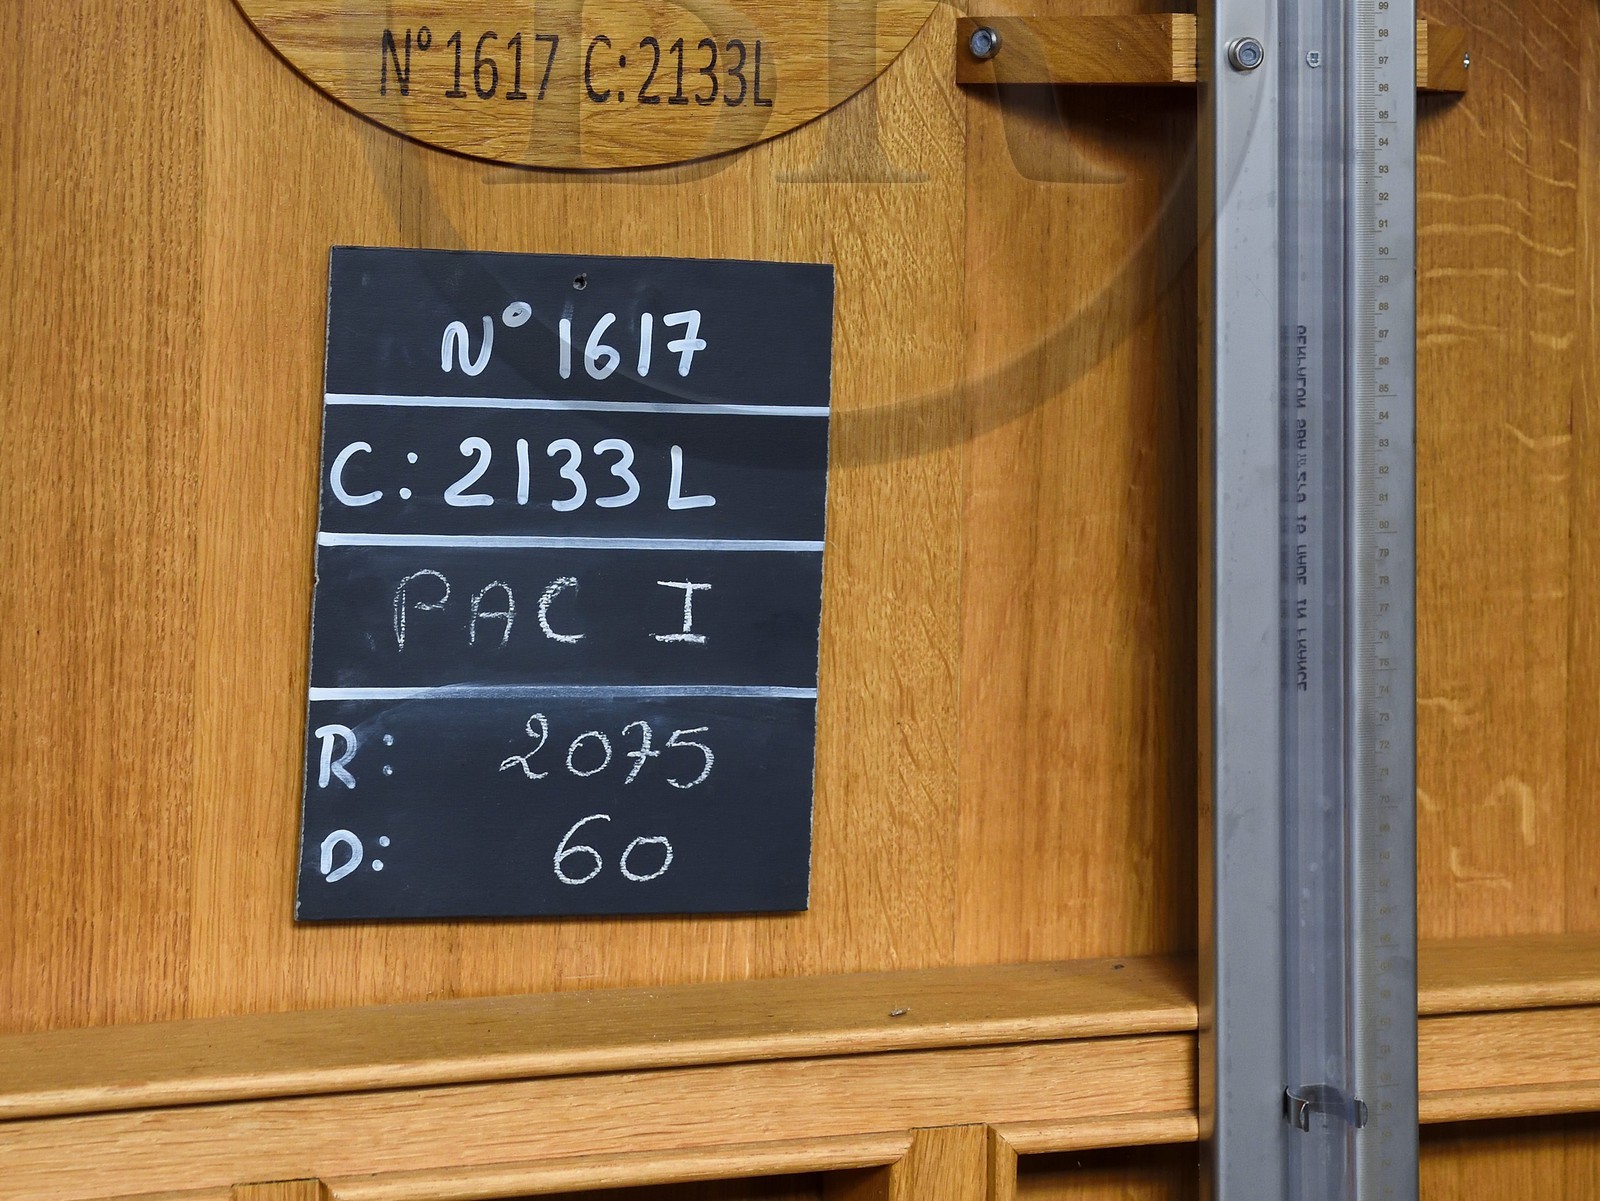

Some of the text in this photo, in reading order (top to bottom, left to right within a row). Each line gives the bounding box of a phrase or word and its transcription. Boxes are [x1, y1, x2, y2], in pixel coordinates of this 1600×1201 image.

[1378, 1, 1389, 11] 99
[1378, 28, 1389, 38] 98
[1378, 55, 1389, 65] 97
[1378, 83, 1389, 93] 96
[1378, 110, 1389, 120] 95
[1378, 137, 1389, 147] 94
[1378, 164, 1390, 174] 93
[1378, 191, 1389, 201] 92
[1378, 219, 1388, 229] 91
[1378, 246, 1389, 256] 90
[1378, 274, 1390, 284] 89
[1378, 301, 1390, 311] 88
[1378, 329, 1389, 339] 87
[559, 310, 706, 380] 1617
[1378, 356, 1390, 366] 86
[1378, 383, 1390, 393] 85
[1379, 410, 1390, 420] 84
[1379, 438, 1390, 448] 83
[444, 437, 641, 512] 2133
[668, 445, 716, 509] L
[1379, 465, 1390, 475] 82
[1379, 492, 1390, 502] 81
[1379, 520, 1390, 530] 80
[1379, 547, 1390, 557] 79
[1379, 575, 1390, 585] 78
[393, 568, 712, 652] PAC I
[1379, 602, 1390, 612] 77
[315, 713, 714, 789] R: 2075
[554, 814, 674, 885] 60
